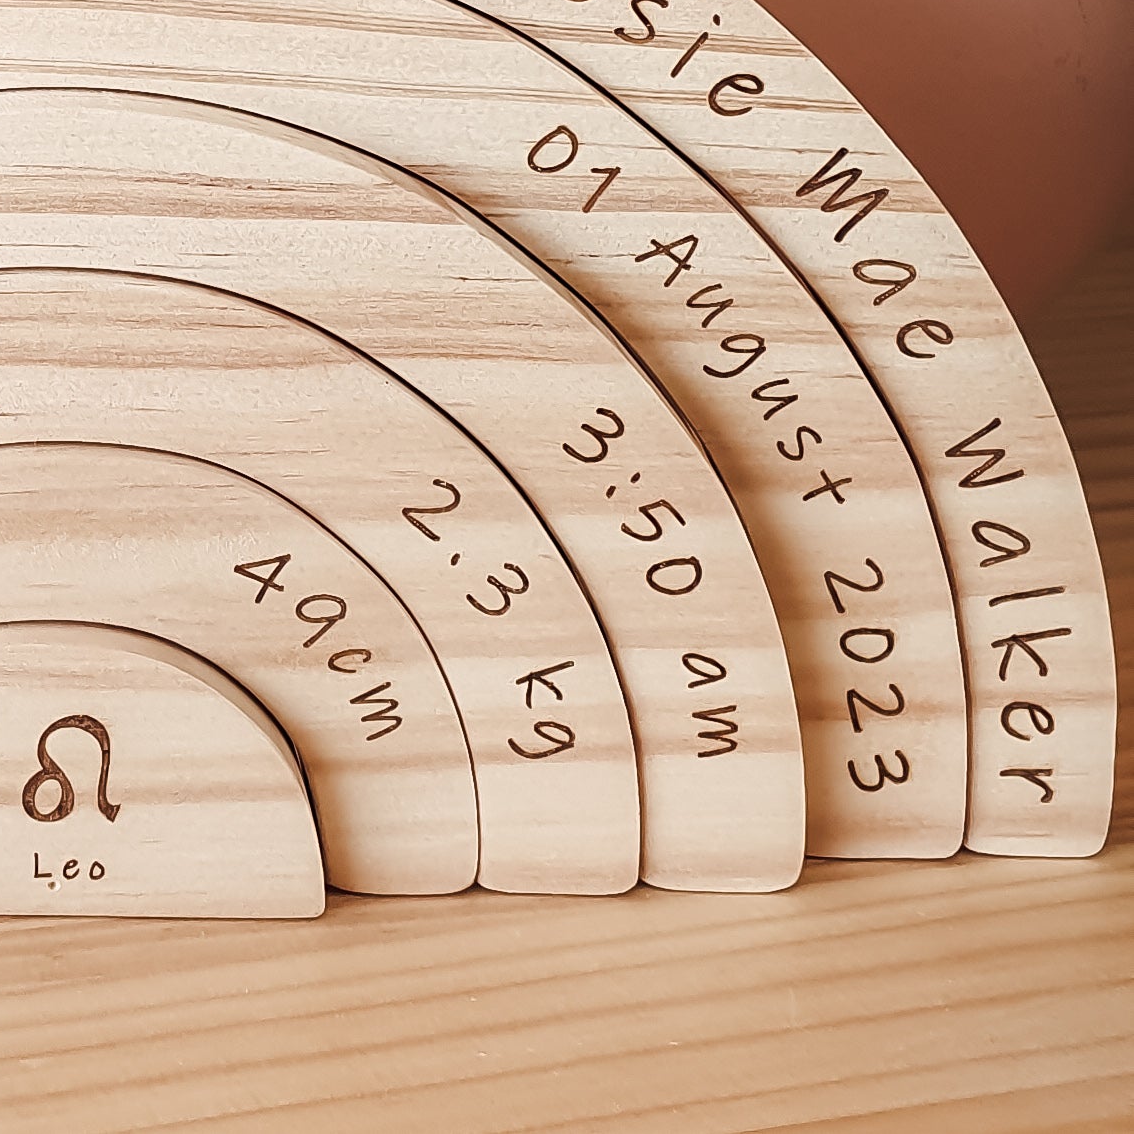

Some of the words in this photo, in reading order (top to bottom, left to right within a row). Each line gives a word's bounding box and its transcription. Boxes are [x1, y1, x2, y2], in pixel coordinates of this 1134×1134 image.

[527, 125, 621, 214] 01
[635, 234, 852, 506] August
[823, 557, 911, 793] 2023
[561, 407, 703, 596] 3:50
[681, 652, 739, 759] am
[795, 147, 956, 359] Mae
[943, 416, 1072, 804] Walker
[233, 553, 404, 742] 49cm
[402, 478, 530, 616] 2.3
[507, 660, 576, 760] kg
[33, 852, 106, 881] Leo
